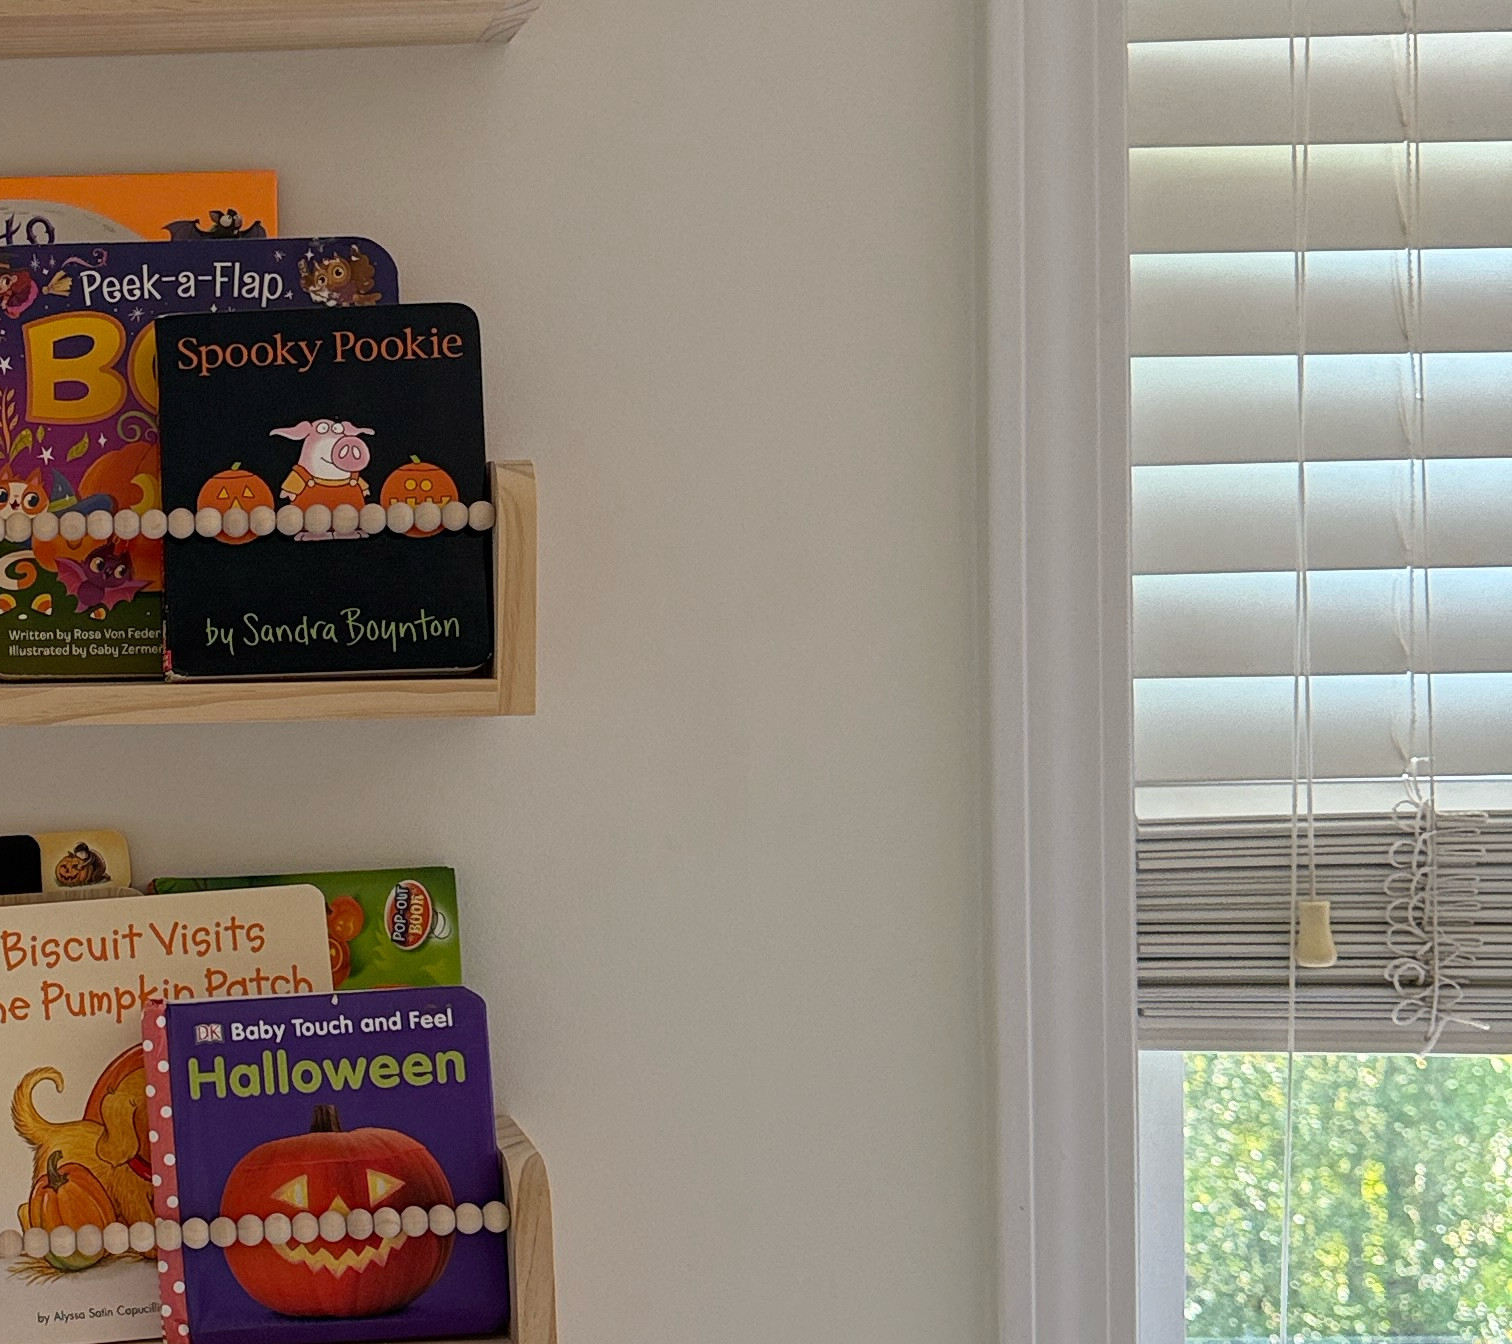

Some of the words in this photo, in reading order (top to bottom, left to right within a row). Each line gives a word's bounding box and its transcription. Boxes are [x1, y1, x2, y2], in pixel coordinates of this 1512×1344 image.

[79, 261, 284, 307] Peek-a-Flap
[177, 331, 323, 377] Spooky
[331, 327, 464, 363] Pookie
[7, 628, 55, 641] Written
[56, 628, 72, 643] by
[74, 628, 102, 640] Rosa
[104, 627, 126, 640] Von
[128, 627, 161, 639] Feder
[8, 644, 70, 657] Illustrated
[72, 644, 88, 659] by
[89, 643, 119, 658] Gaby
[206, 617, 235, 656] by
[243, 612, 338, 646] Sandra
[340, 606, 460, 653] Boynton
[392, 885, 409, 942] POP-OUT
[408, 893, 425, 936] BOOK
[0, 923, 143, 971] Biscuit
[149, 916, 266, 958] Visits
[41, 973, 196, 1024] Pumpkin
[204, 964, 315, 998] Patch
[196, 1023, 223, 1043] DK
[231, 1019, 285, 1044] Baby
[291, 1014, 354, 1038] Touch
[360, 1011, 402, 1033] and
[408, 1008, 454, 1029] Feel
[188, 1049, 467, 1100] Halloween
[37, 1312, 50, 1326] by
[53, 1309, 86, 1324] Alyssa
[88, 1307, 114, 1319] Satin
